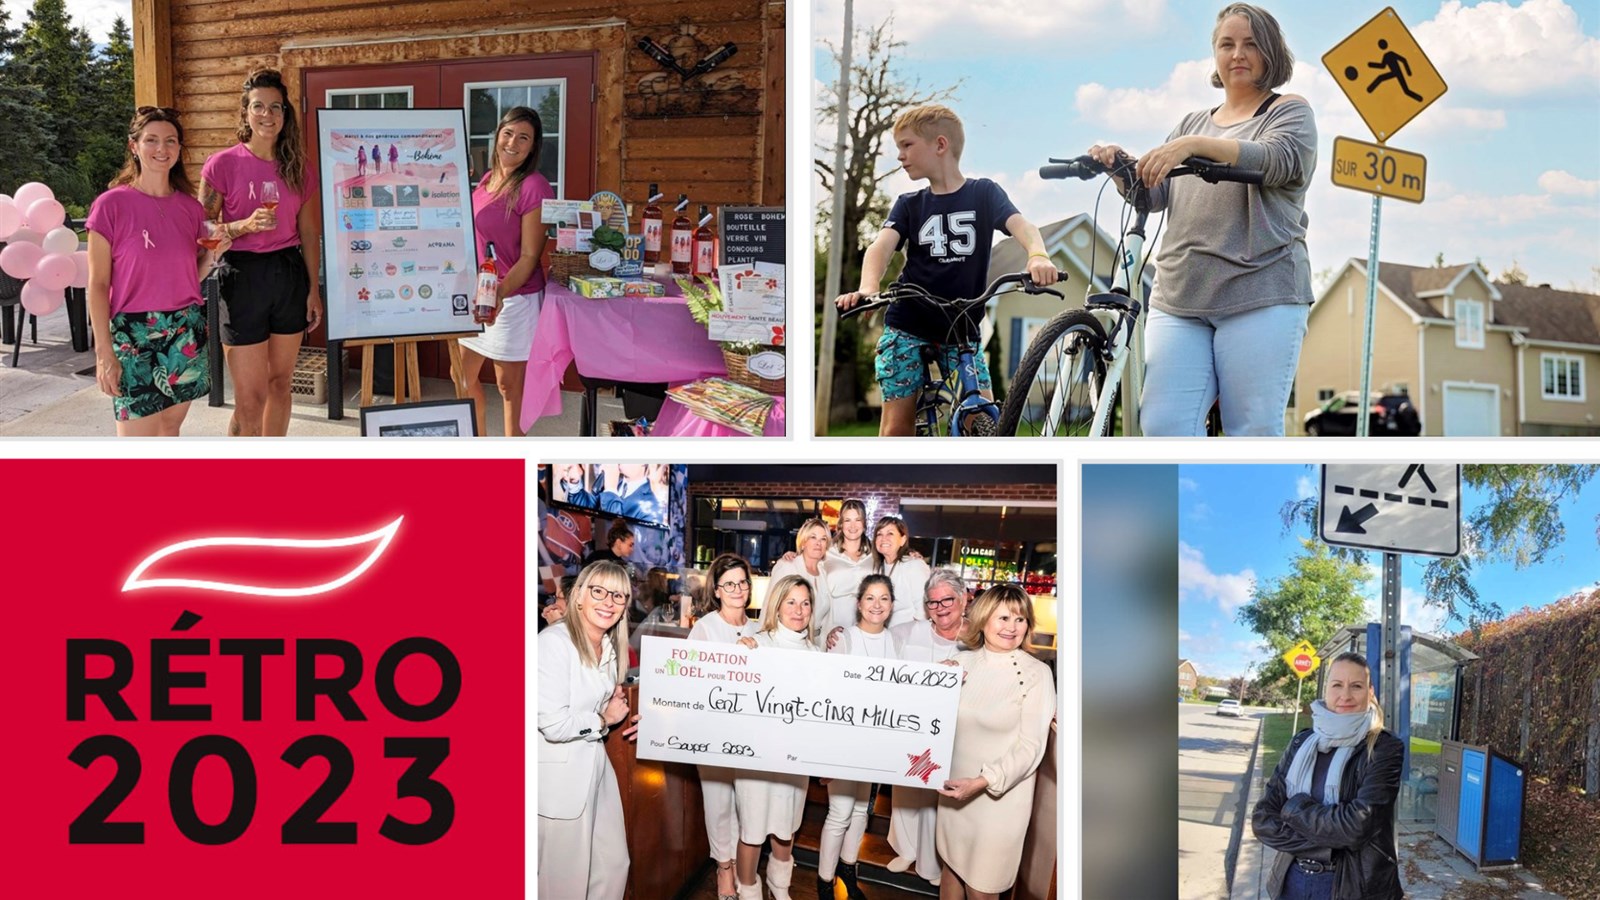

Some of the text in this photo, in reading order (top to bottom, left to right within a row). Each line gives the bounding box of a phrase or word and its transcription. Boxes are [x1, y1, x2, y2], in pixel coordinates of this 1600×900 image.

[1335, 151, 1421, 191] SUR 30 m
[431, 190, 460, 199] isolation
[726, 234, 750, 242] VERRE
[918, 210, 977, 257] 45
[726, 245, 764, 253] CONCOURS
[727, 256, 755, 264] PLANTE
[711, 313, 747, 321] MOUVEMENT
[971, 547, 979, 556] LA
[671, 648, 748, 666] FODATION
[668, 663, 705, 679] OËL
[727, 670, 762, 684] TOUS
[843, 670, 862, 680] Date
[865, 665, 885, 682] 29
[920, 669, 959, 689] 2023
[652, 697, 705, 711] Montant de
[930, 717, 941, 736] $
[650, 739, 665, 748] Pour
[722, 741, 755, 758] 2023
[786, 754, 798, 762] Par
